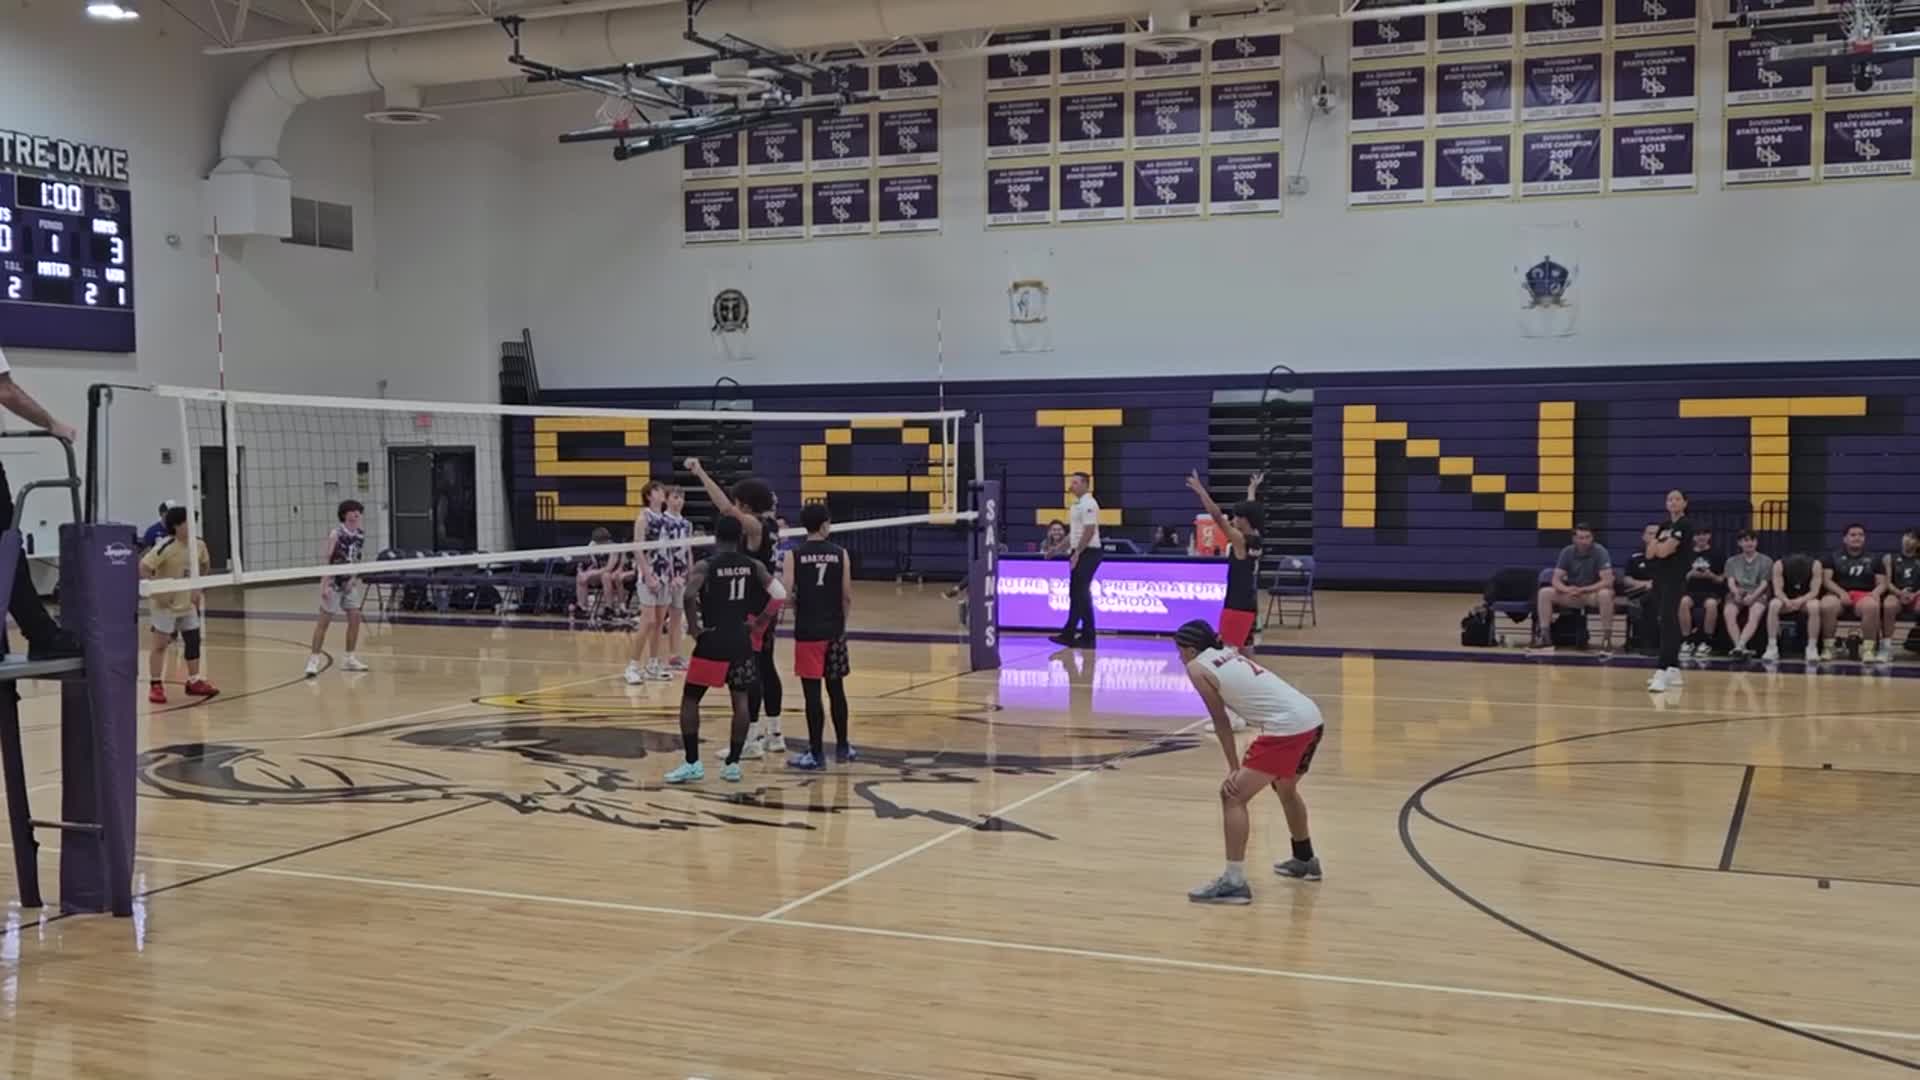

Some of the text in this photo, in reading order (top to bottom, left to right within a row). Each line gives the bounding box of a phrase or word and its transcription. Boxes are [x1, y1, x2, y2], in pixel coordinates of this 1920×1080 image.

[1552, 73, 1574, 83] 2011
[1641, 67, 1667, 76] 2012
[1376, 87, 1400, 96] 2010
[1461, 80, 1487, 89] 2010
[1754, 135, 1783, 145] 2014
[1853, 128, 1883, 138] 2015
[1550, 149, 1574, 159] 2011
[1640, 143, 1666, 153] 2013
[58, 141, 128, 180] DAME
[1375, 159, 1400, 169] 2010
[41, 182, 82, 212] 1:00
[51, 234, 59, 253] 1
[110, 237, 124, 264] 3
[8, 276, 22, 298] 2
[84, 283, 98, 305] 2
[118, 287, 126, 305] 1
[815, 563, 828, 586] 7
[984, 498, 996, 648] SAINTS
[728, 577, 746, 600] 11
